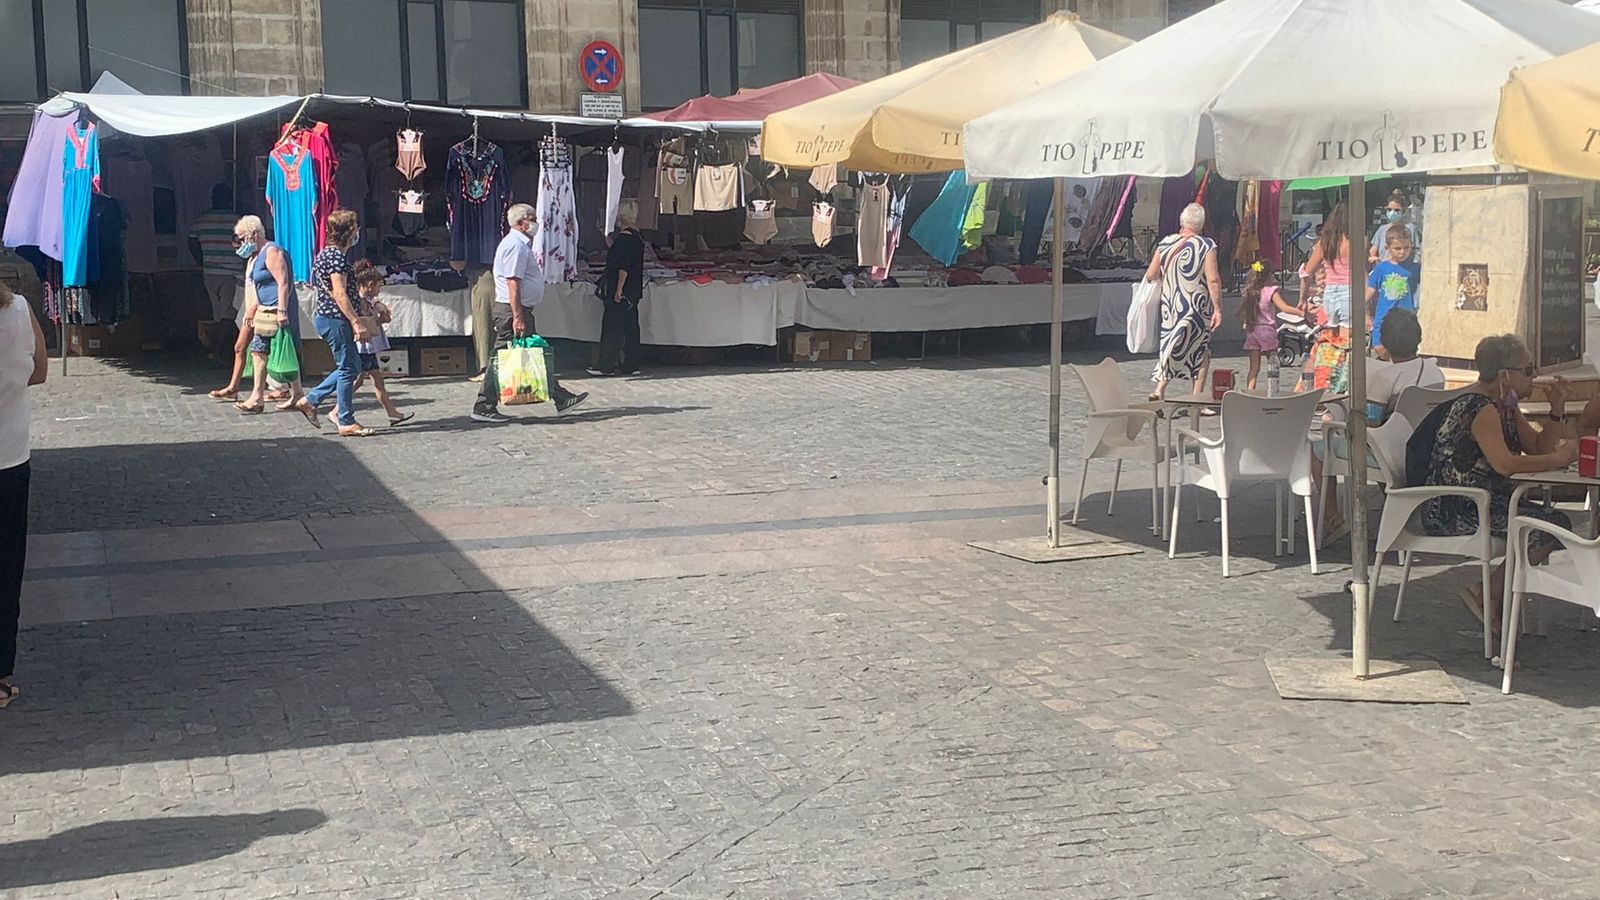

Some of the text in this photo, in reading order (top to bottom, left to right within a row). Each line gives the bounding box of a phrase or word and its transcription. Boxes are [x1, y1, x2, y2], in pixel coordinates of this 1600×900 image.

[795, 139, 846, 154] TIO PEPE
[940, 131, 960, 146] TI
[1317, 130, 1488, 161] TIO PEPE
[1041, 140, 1146, 162] TIO PEPE
